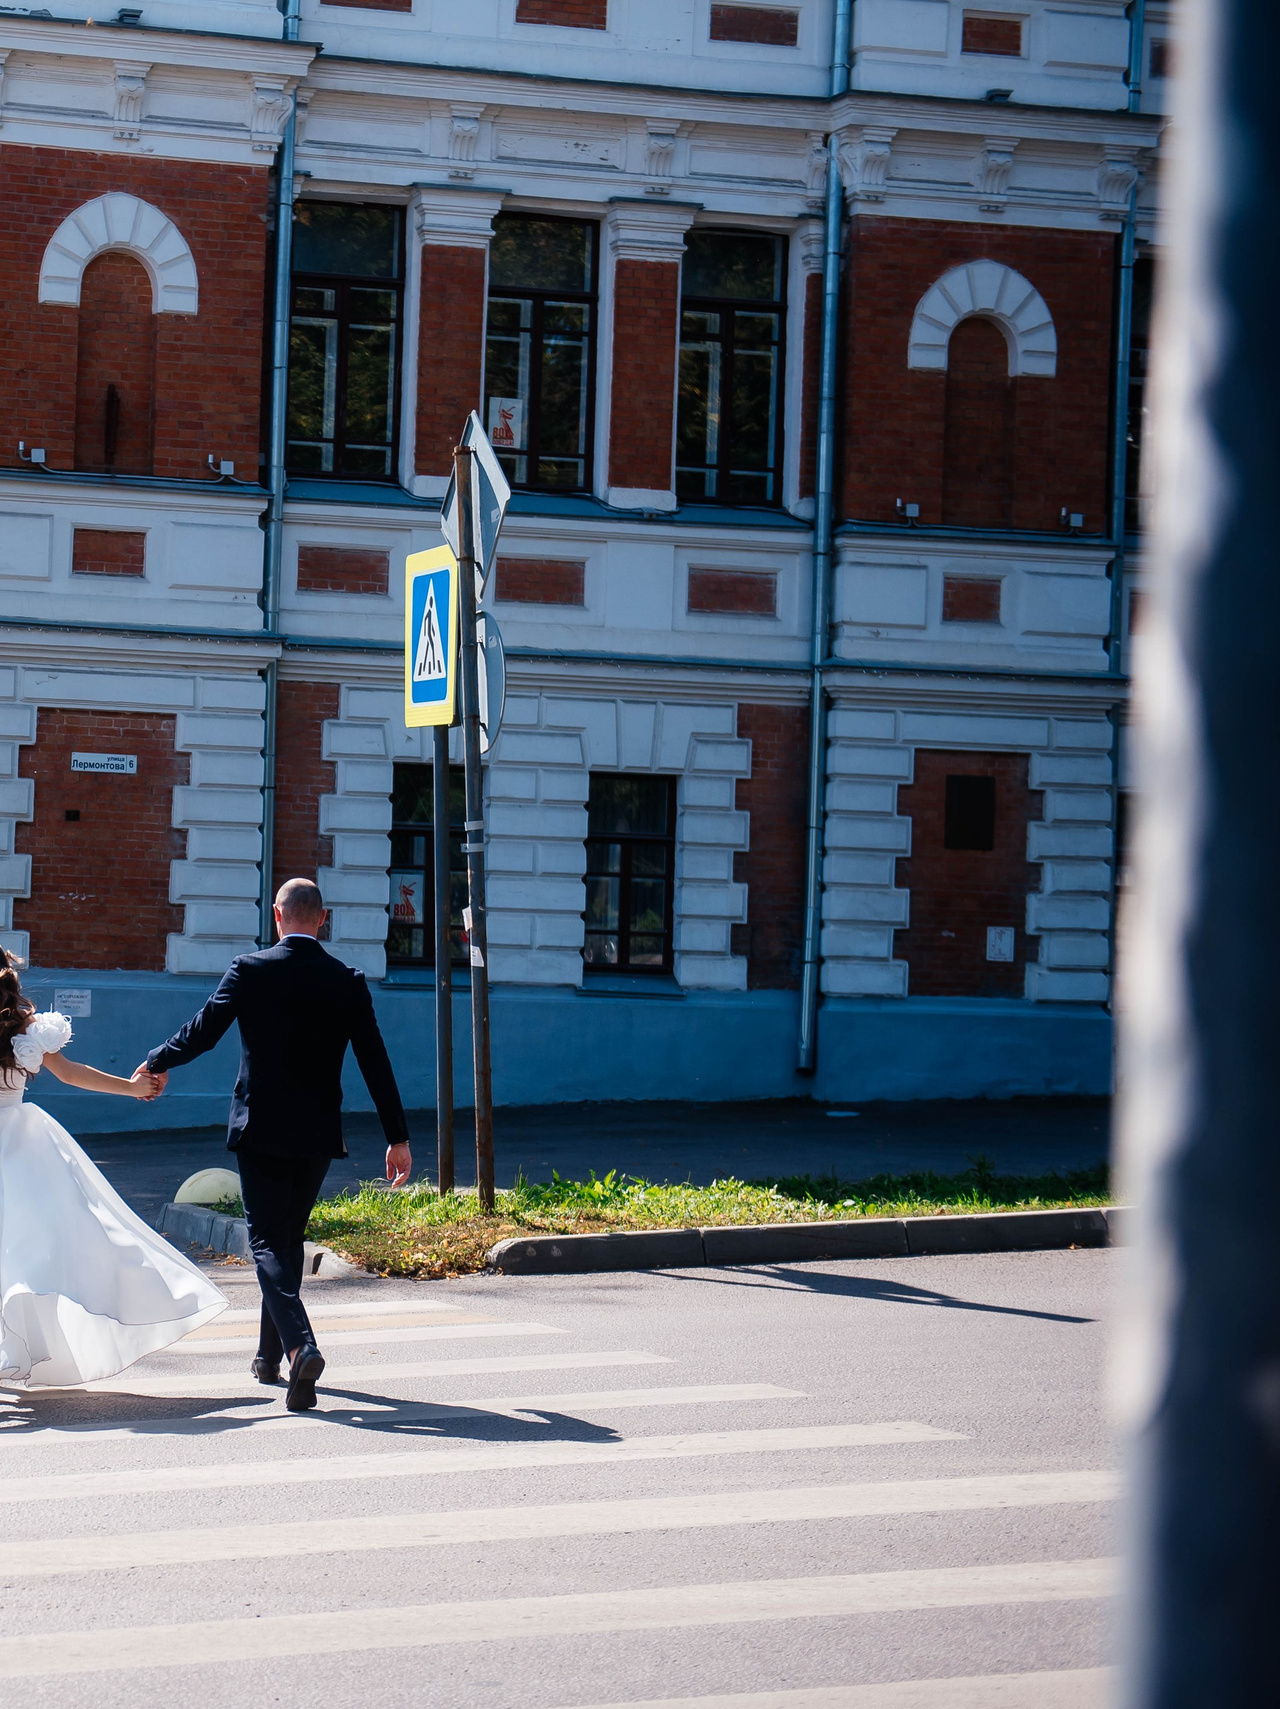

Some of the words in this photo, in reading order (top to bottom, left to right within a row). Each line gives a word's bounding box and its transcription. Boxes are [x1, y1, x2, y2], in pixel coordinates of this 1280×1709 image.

[493, 427, 505, 439] 80
[72, 759, 125, 770] Лермонтова
[128, 760, 134, 768] 6
[394, 904, 406, 915] 80
